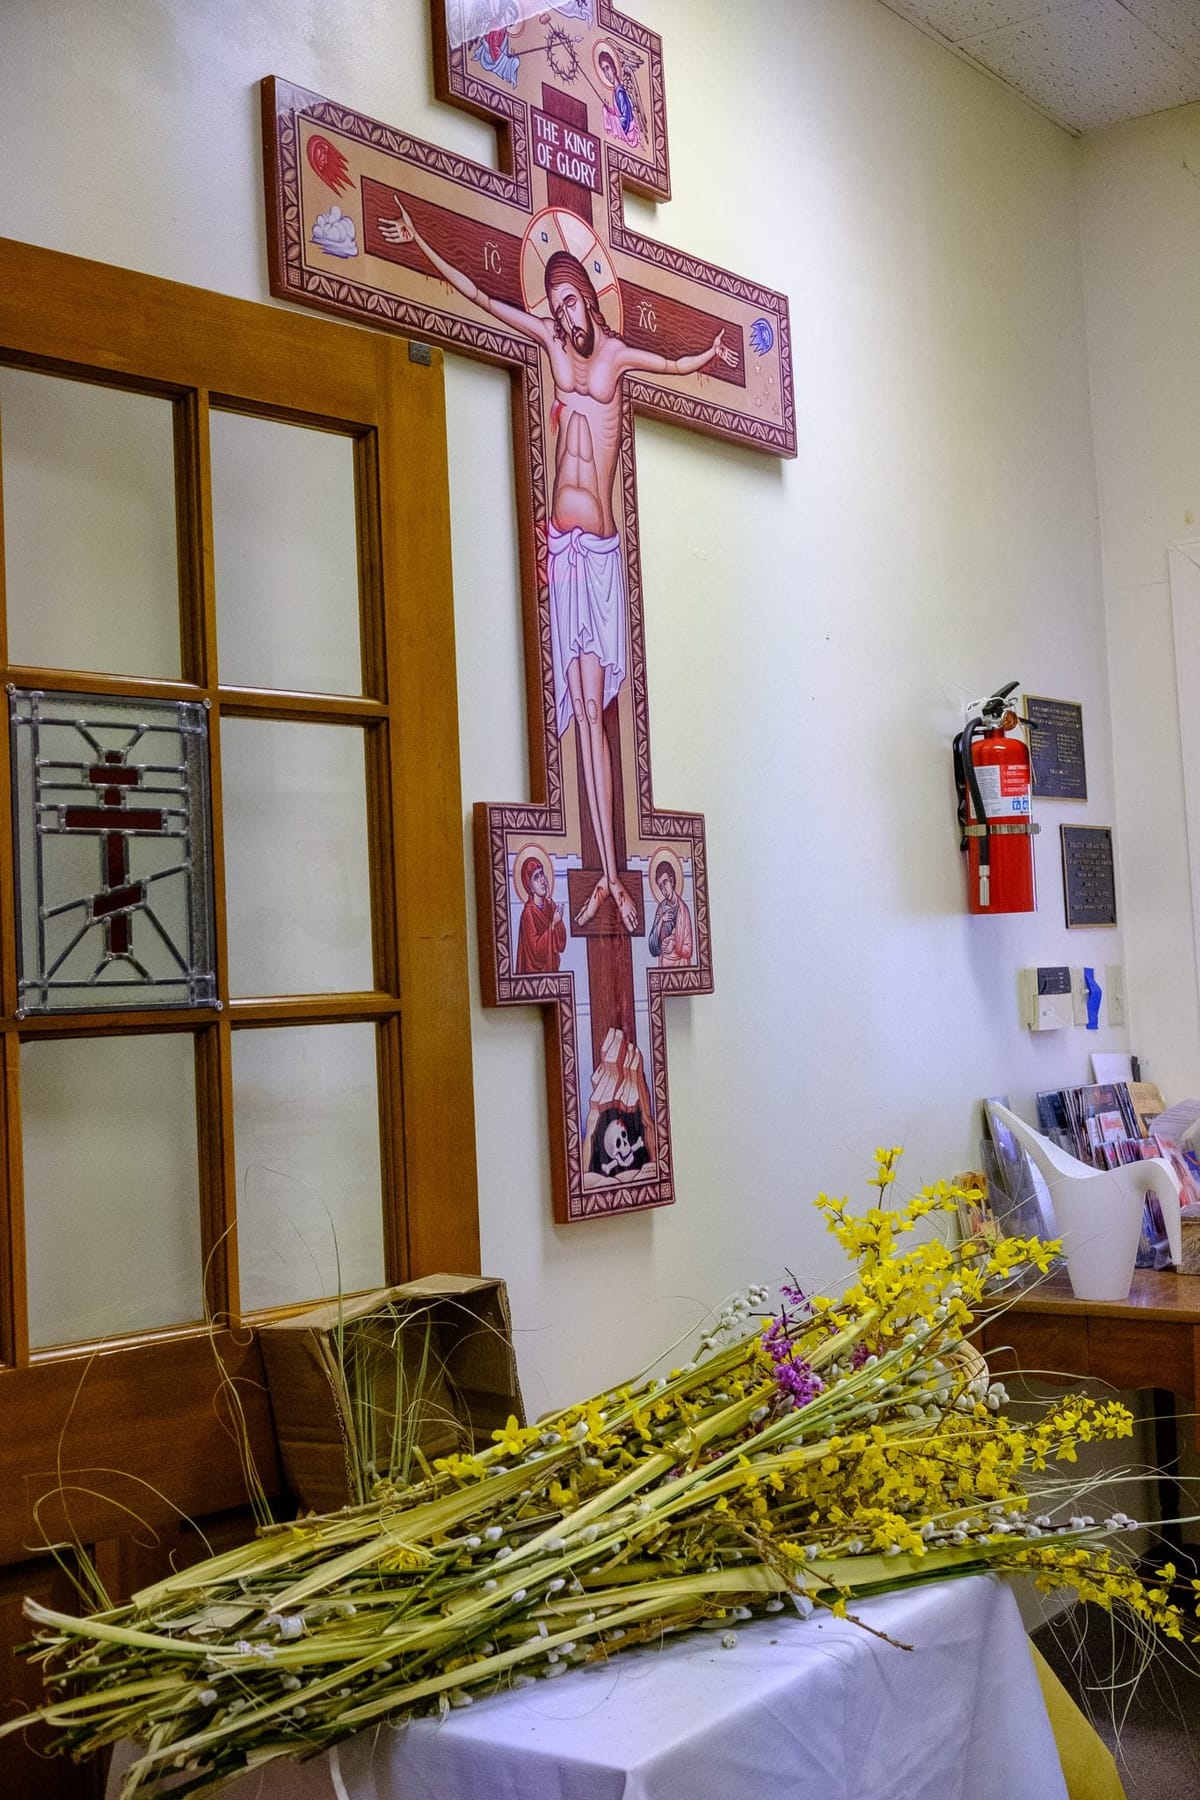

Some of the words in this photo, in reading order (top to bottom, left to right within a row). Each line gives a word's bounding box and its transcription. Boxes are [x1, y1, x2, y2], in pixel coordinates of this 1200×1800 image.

[534, 114, 559, 145] THE
[564, 129, 595, 161] KING
[537, 143, 553, 168] OF
[557, 152, 596, 188] GLORY
